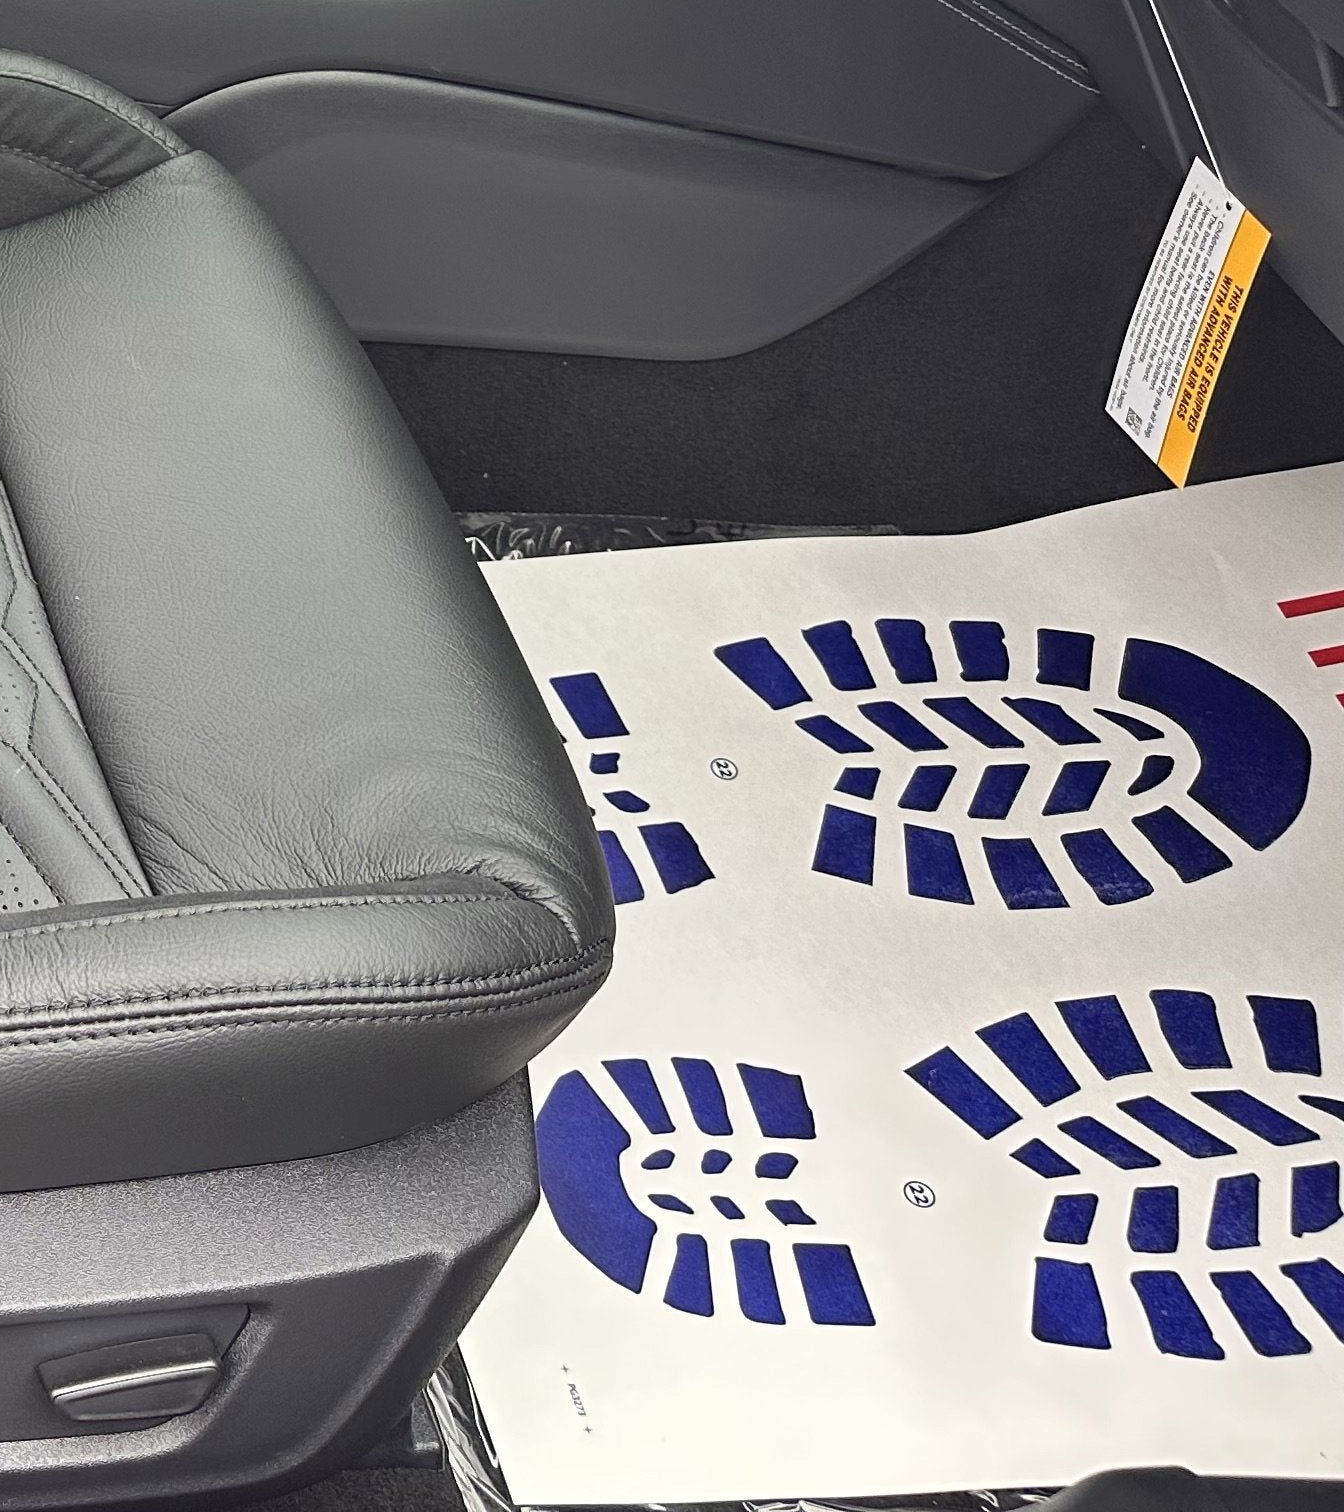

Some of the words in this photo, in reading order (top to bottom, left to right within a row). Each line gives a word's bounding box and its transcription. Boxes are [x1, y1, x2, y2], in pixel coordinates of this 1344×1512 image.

[1202, 270, 1215, 294] EVEN
[1215, 275, 1233, 307] WITH
[1194, 293, 1206, 317] WITH
[1227, 284, 1244, 313] THIS
[1178, 316, 1197, 360] ADVANCED
[1194, 306, 1220, 368] ADVANCED
[1209, 313, 1233, 363] VEHICLE
[1173, 359, 1183, 376] AIR
[1186, 366, 1199, 389] AIR
[1204, 361, 1215, 377] IS
[1166, 375, 1178, 399] BAGS
[1176, 388, 1192, 421] BAGS
[1187, 375, 1210, 433] EQUIPPED
